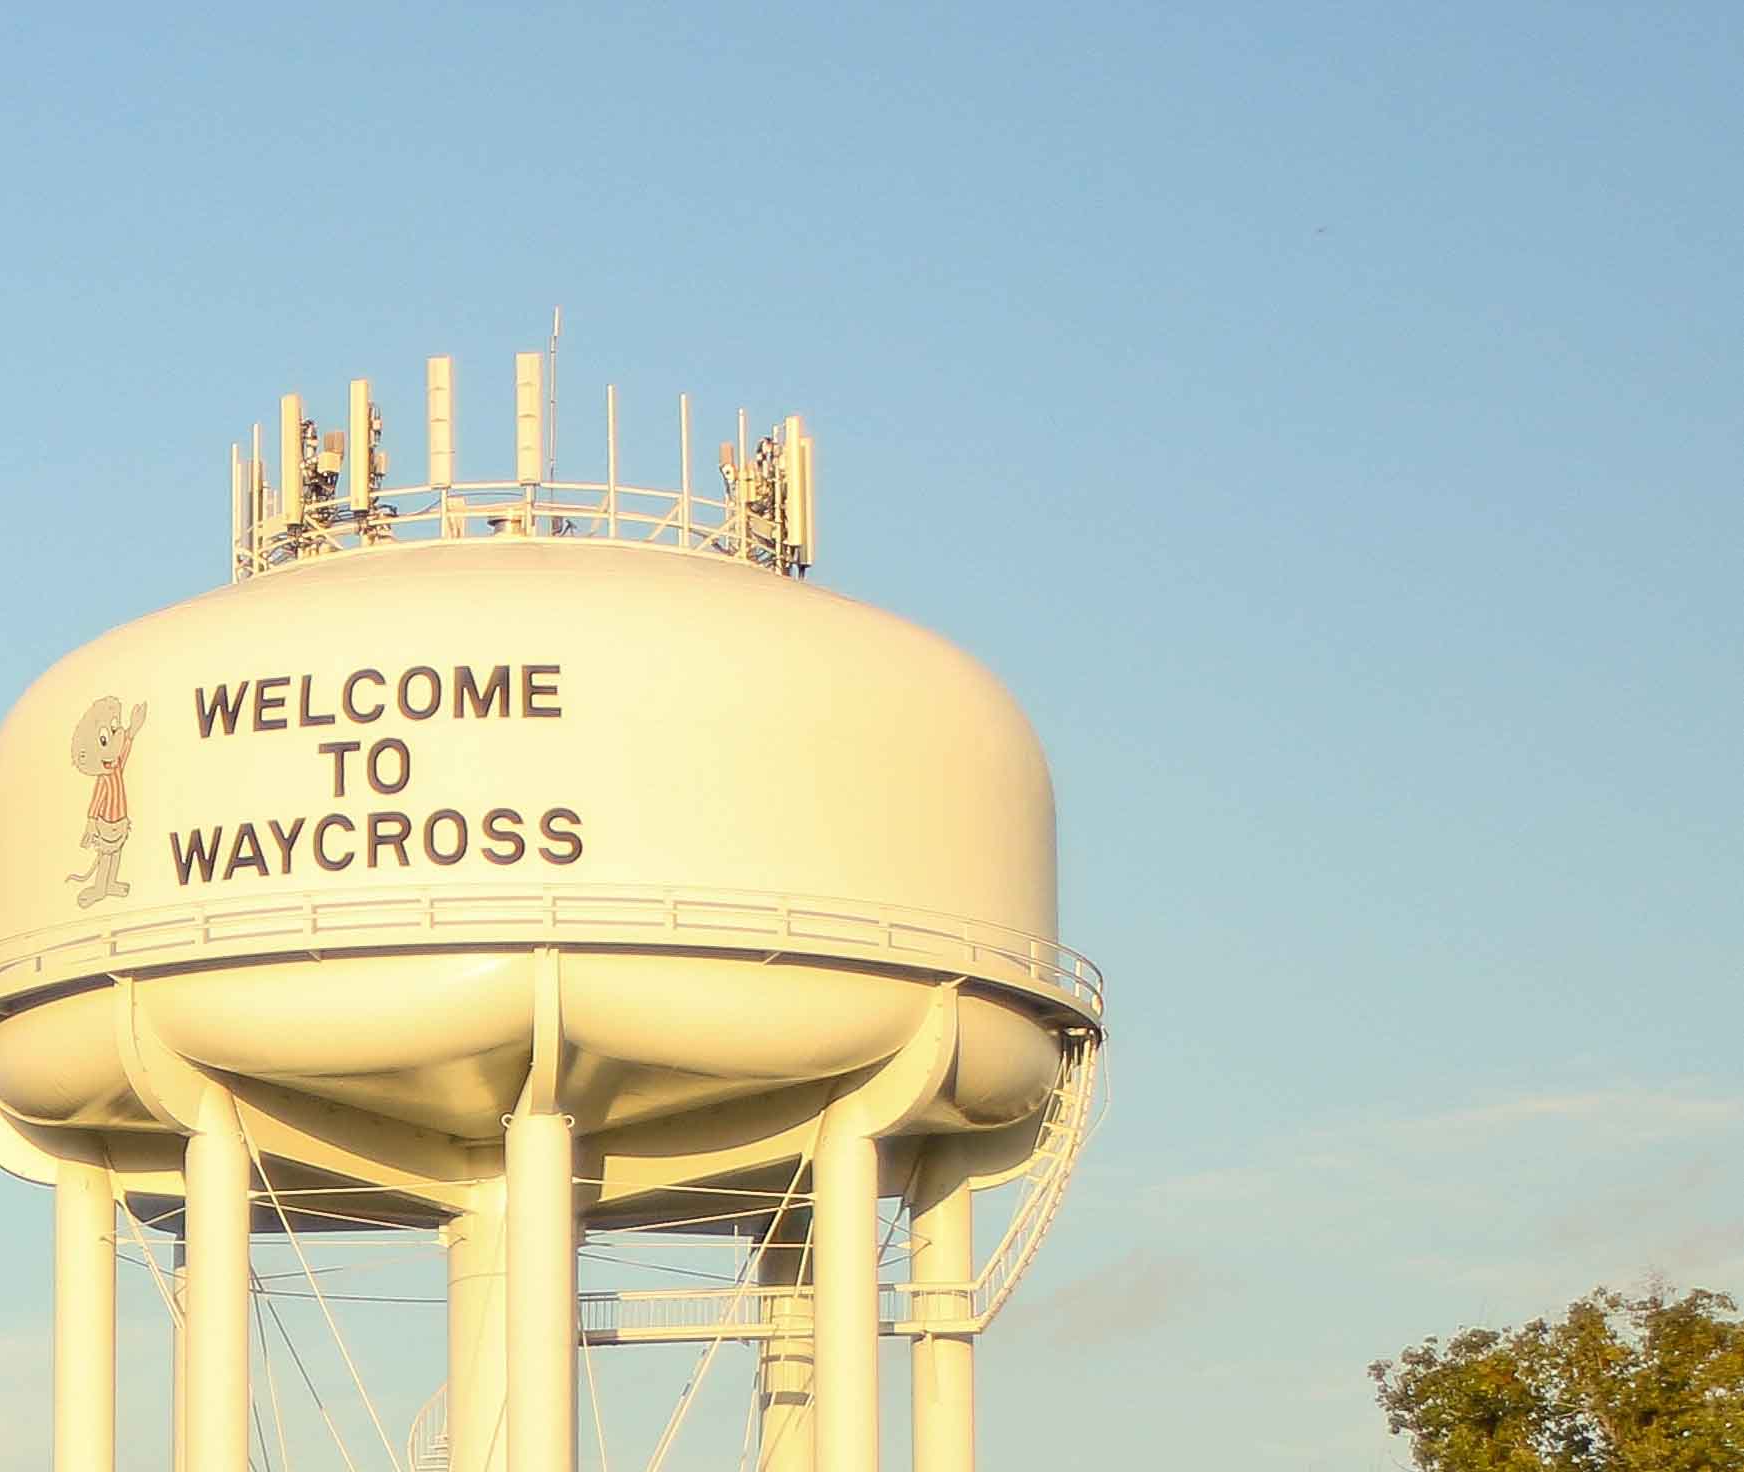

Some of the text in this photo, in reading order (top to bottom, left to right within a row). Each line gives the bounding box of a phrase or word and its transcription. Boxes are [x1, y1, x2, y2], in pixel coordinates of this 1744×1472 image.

[195, 664, 562, 739] WELCOME
[318, 737, 411, 798] TO
[169, 807, 584, 886] WAYCROSS
